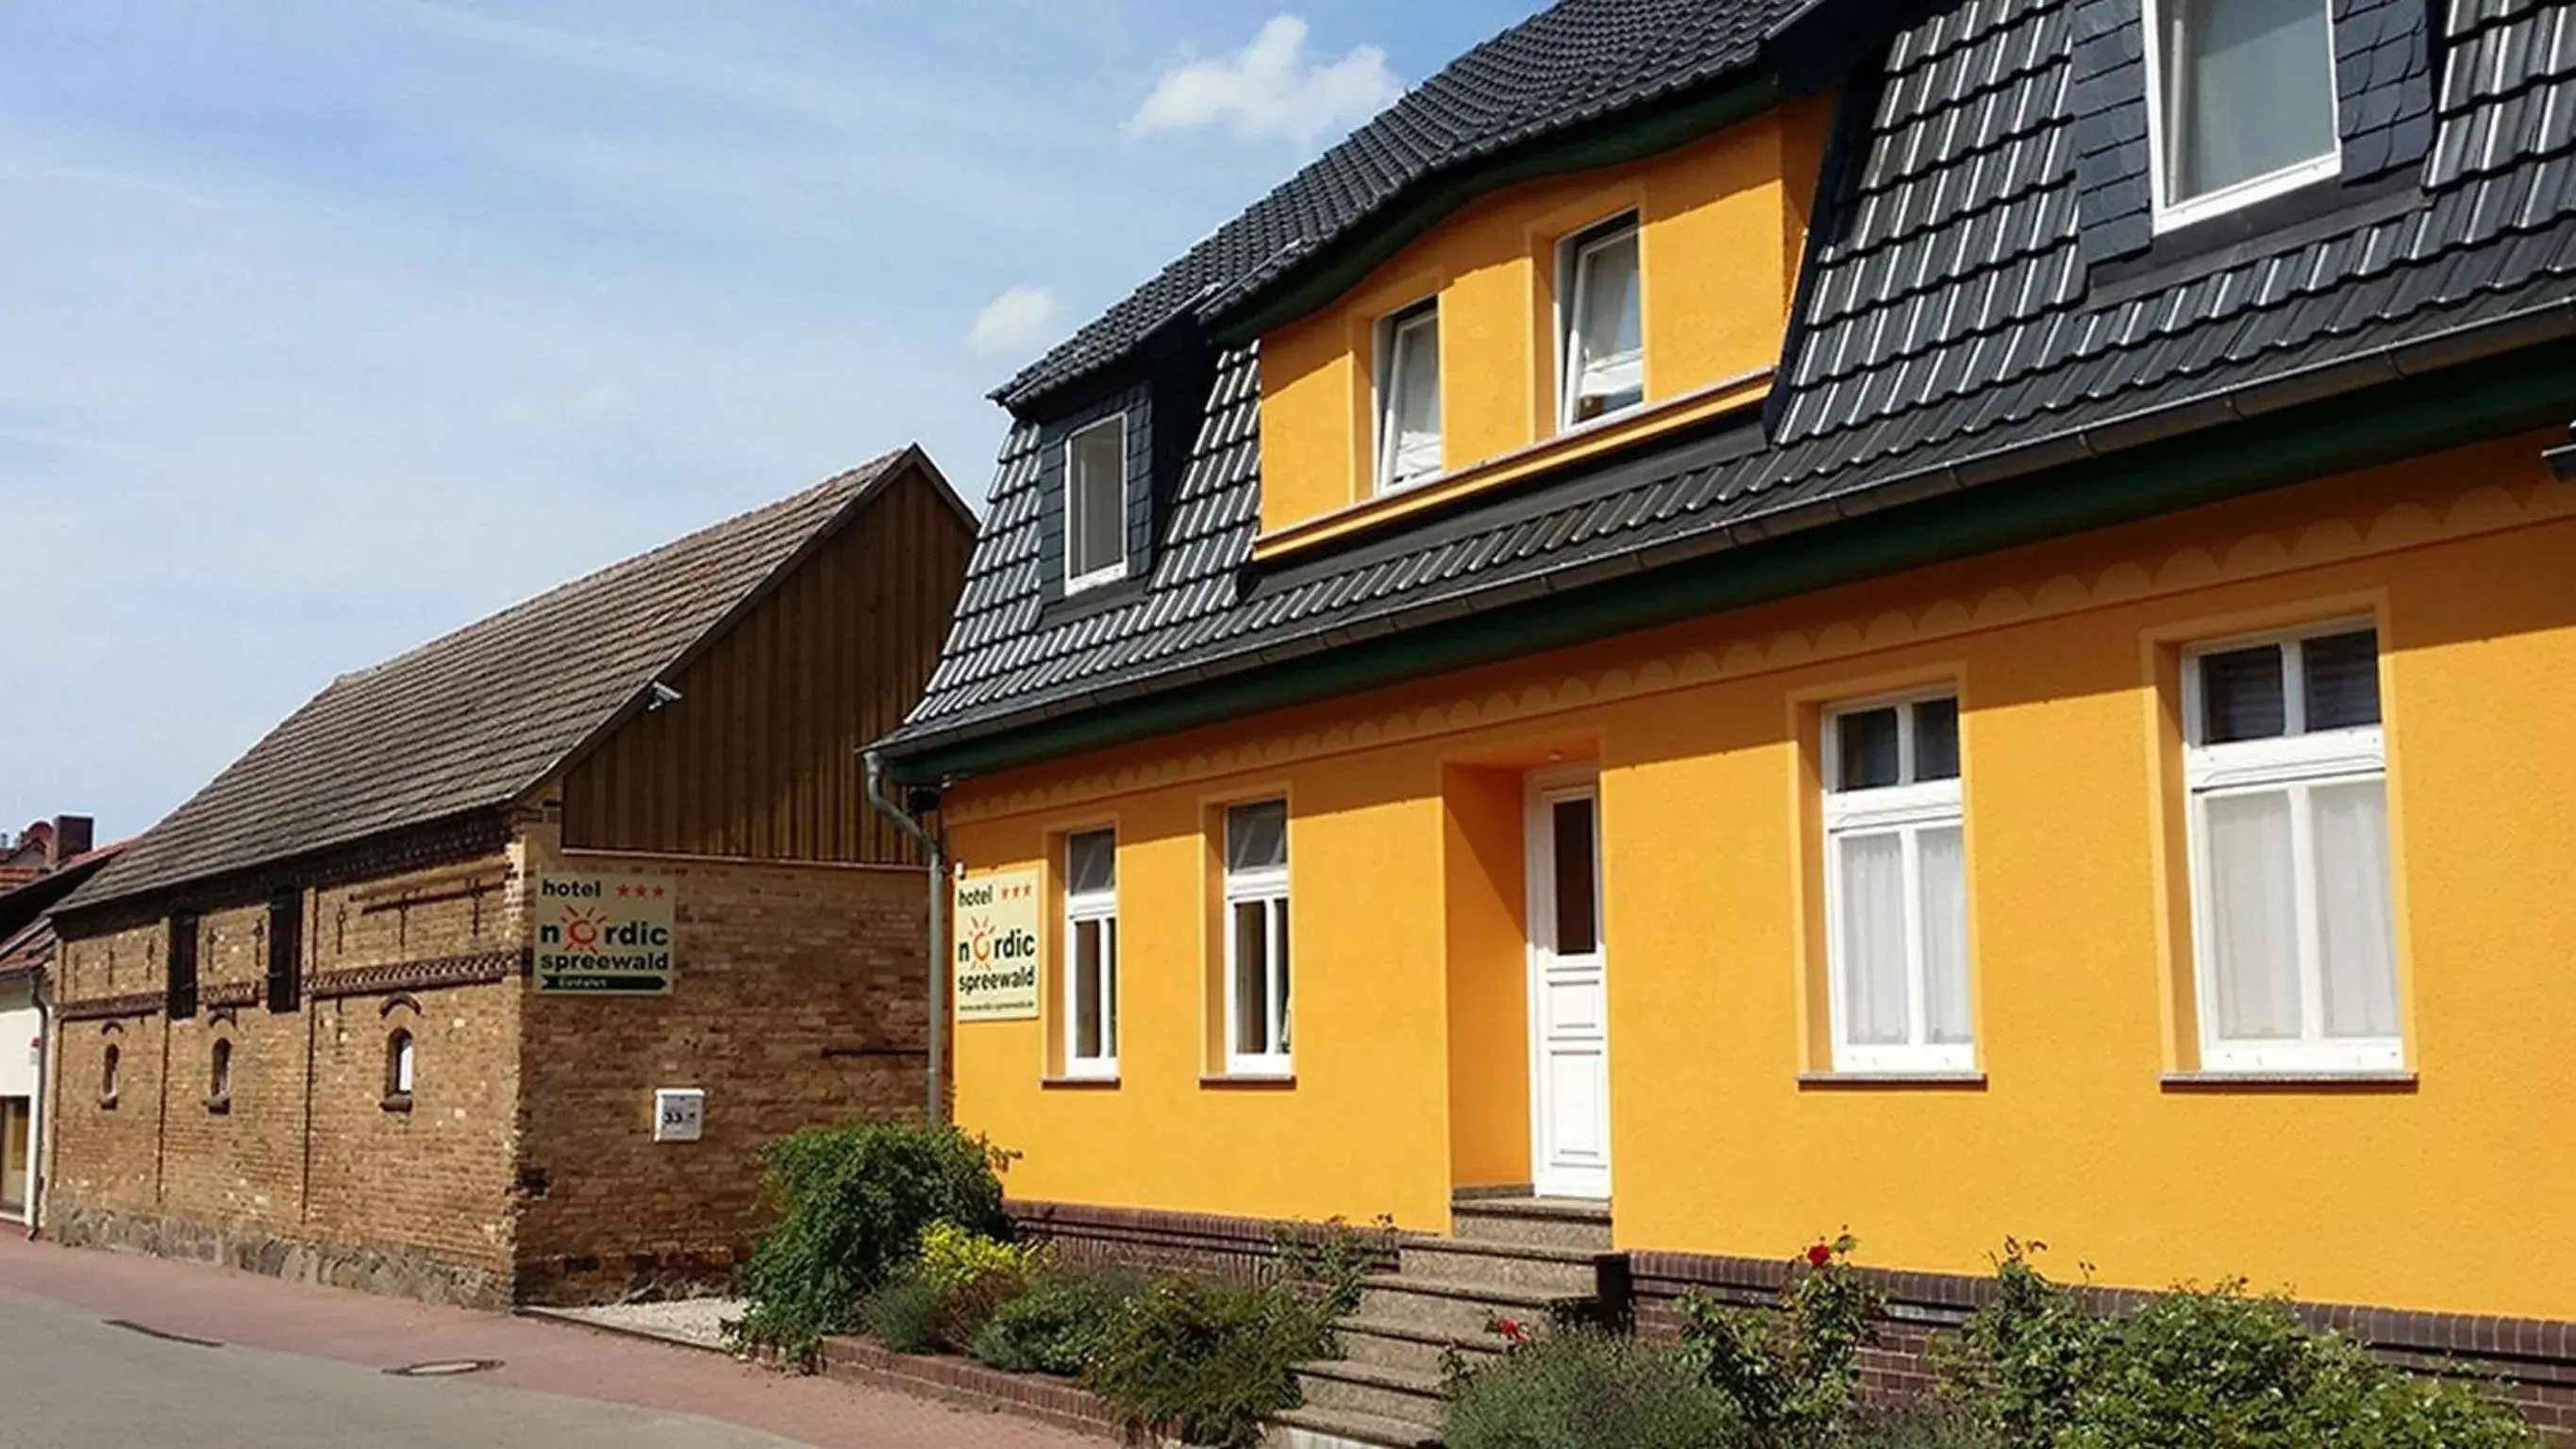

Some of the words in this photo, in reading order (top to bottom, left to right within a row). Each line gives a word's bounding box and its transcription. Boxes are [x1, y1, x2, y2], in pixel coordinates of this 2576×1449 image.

[542, 879, 601, 897] hotel
[958, 885, 993, 908] hotel
[541, 953, 668, 972] spreewald
[958, 966, 1034, 995] spreewald
